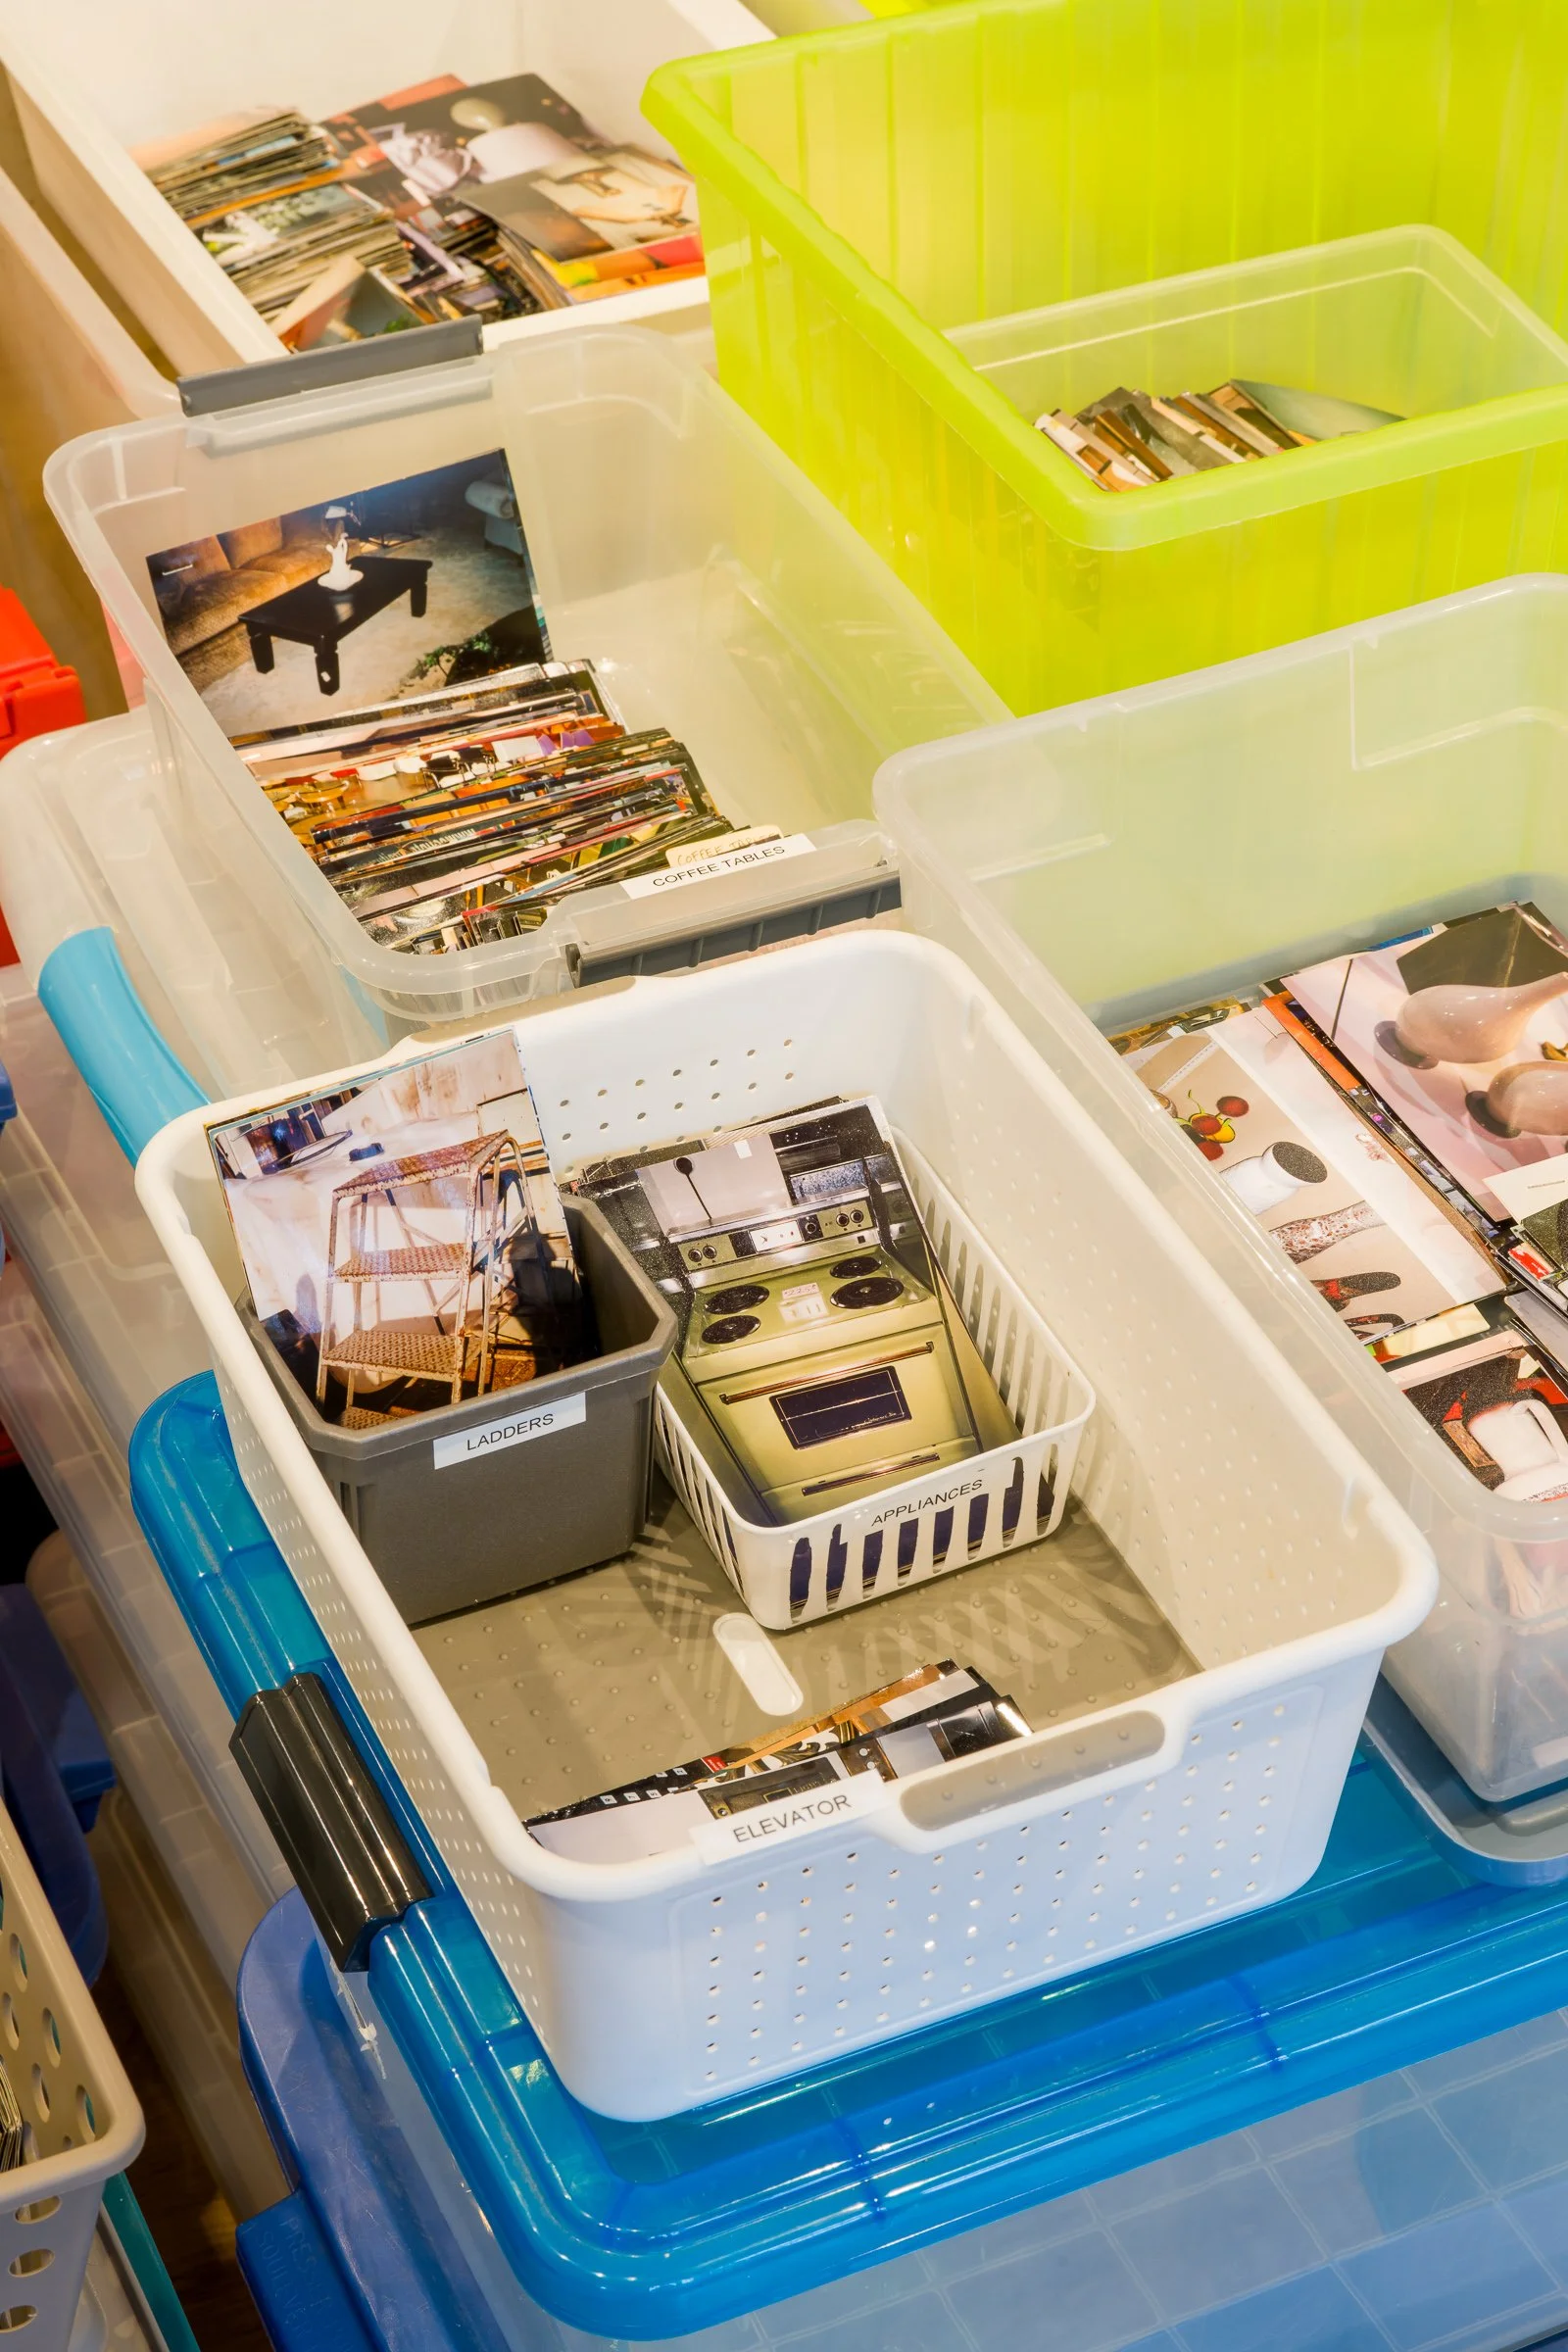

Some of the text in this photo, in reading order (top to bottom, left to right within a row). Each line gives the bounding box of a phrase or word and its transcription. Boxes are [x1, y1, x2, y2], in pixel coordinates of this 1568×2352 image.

[653, 846, 786, 888] COFFEE TABLES
[466, 1412, 555, 1451] LADDERS
[870, 1479, 983, 1527] APPLIANCES
[732, 1794, 853, 1843] ELEVATOR
